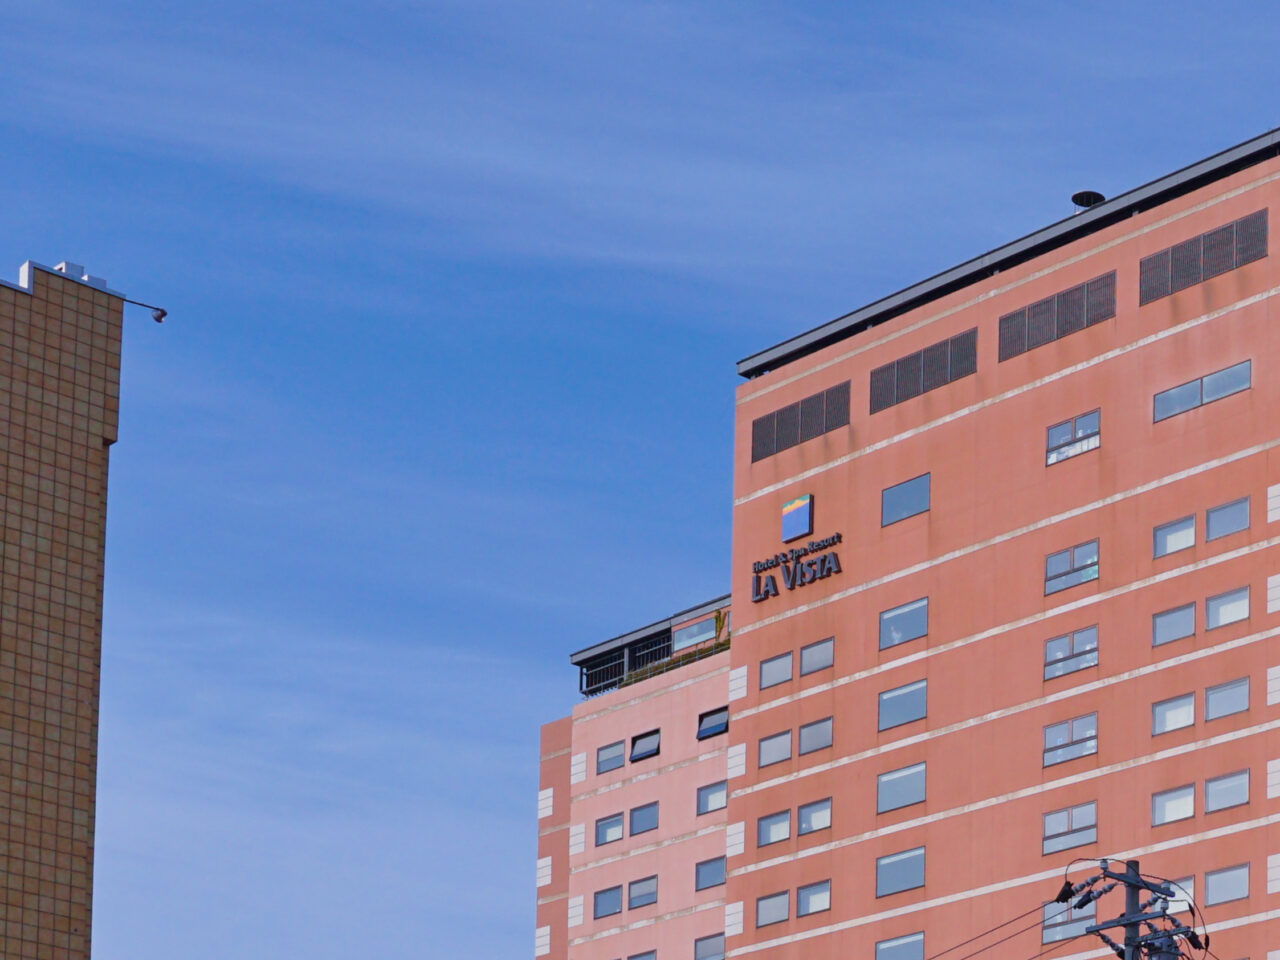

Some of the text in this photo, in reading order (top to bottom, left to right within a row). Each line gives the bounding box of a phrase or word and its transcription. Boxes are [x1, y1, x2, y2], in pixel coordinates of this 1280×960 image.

[752, 555, 778, 573] Hotel
[788, 548, 807, 562] Spa
[807, 532, 842, 553] Resort
[752, 551, 842, 603] LA VISTA
